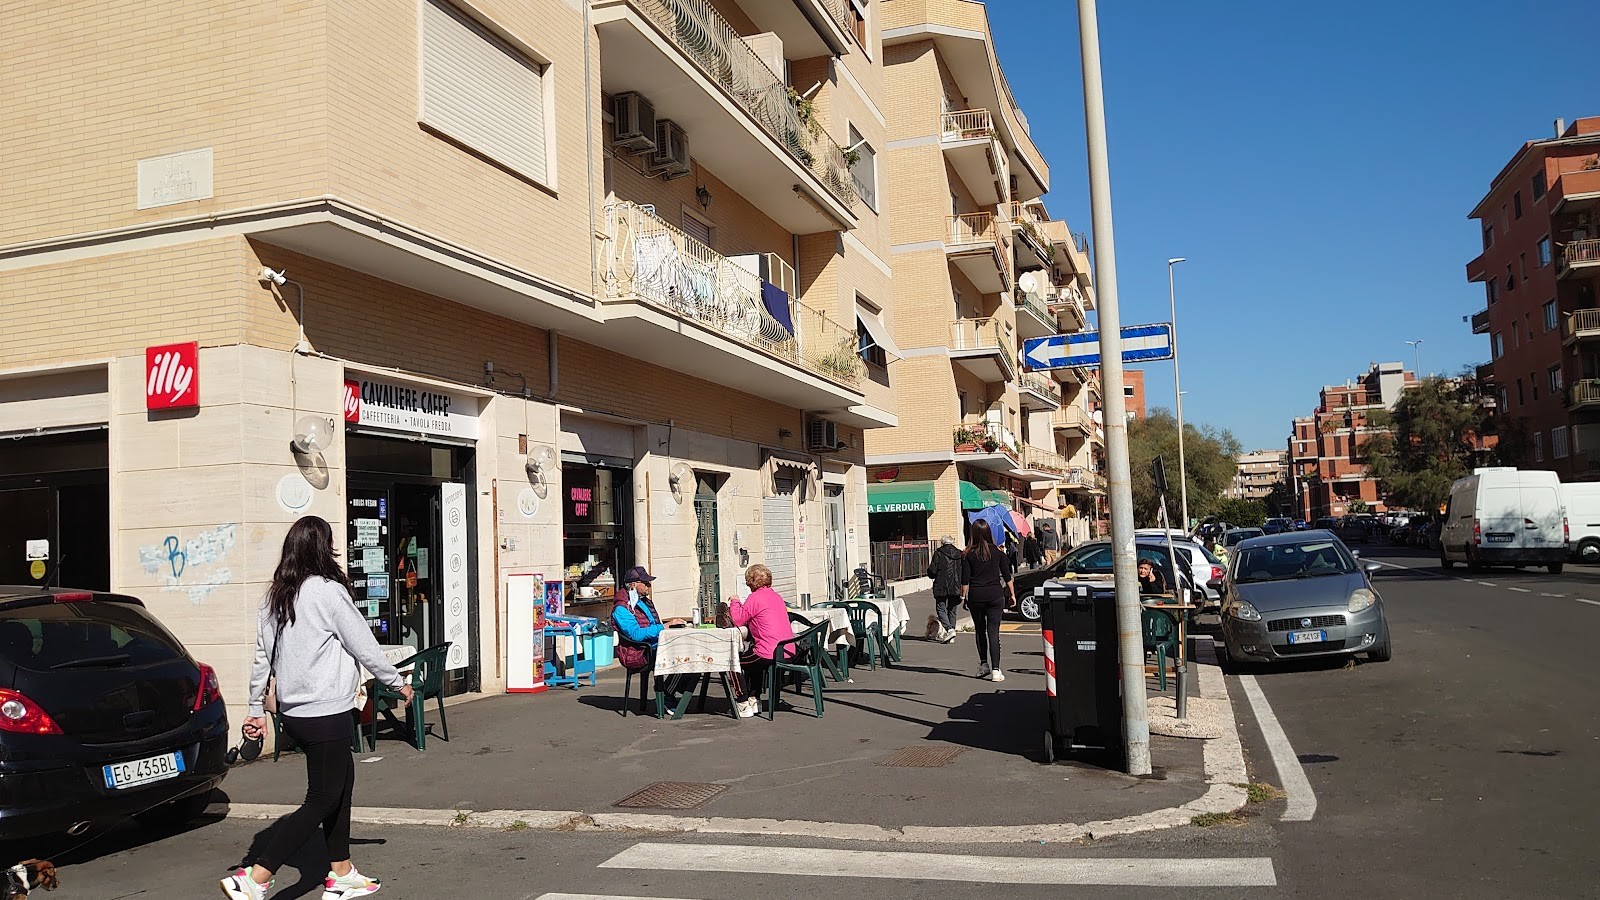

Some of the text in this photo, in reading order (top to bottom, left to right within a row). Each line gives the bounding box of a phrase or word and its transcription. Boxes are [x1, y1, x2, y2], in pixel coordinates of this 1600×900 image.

[147, 351, 193, 403] illy
[361, 381, 418, 413] CAVALIERE
[362, 410, 452, 432] CAFFETTERIA TAVOLA FREDDA
[877, 504, 882, 512] E
[884, 502, 926, 512] VERDURA
[113, 765, 131, 784] EG
[136, 755, 176, 778] 435BL
